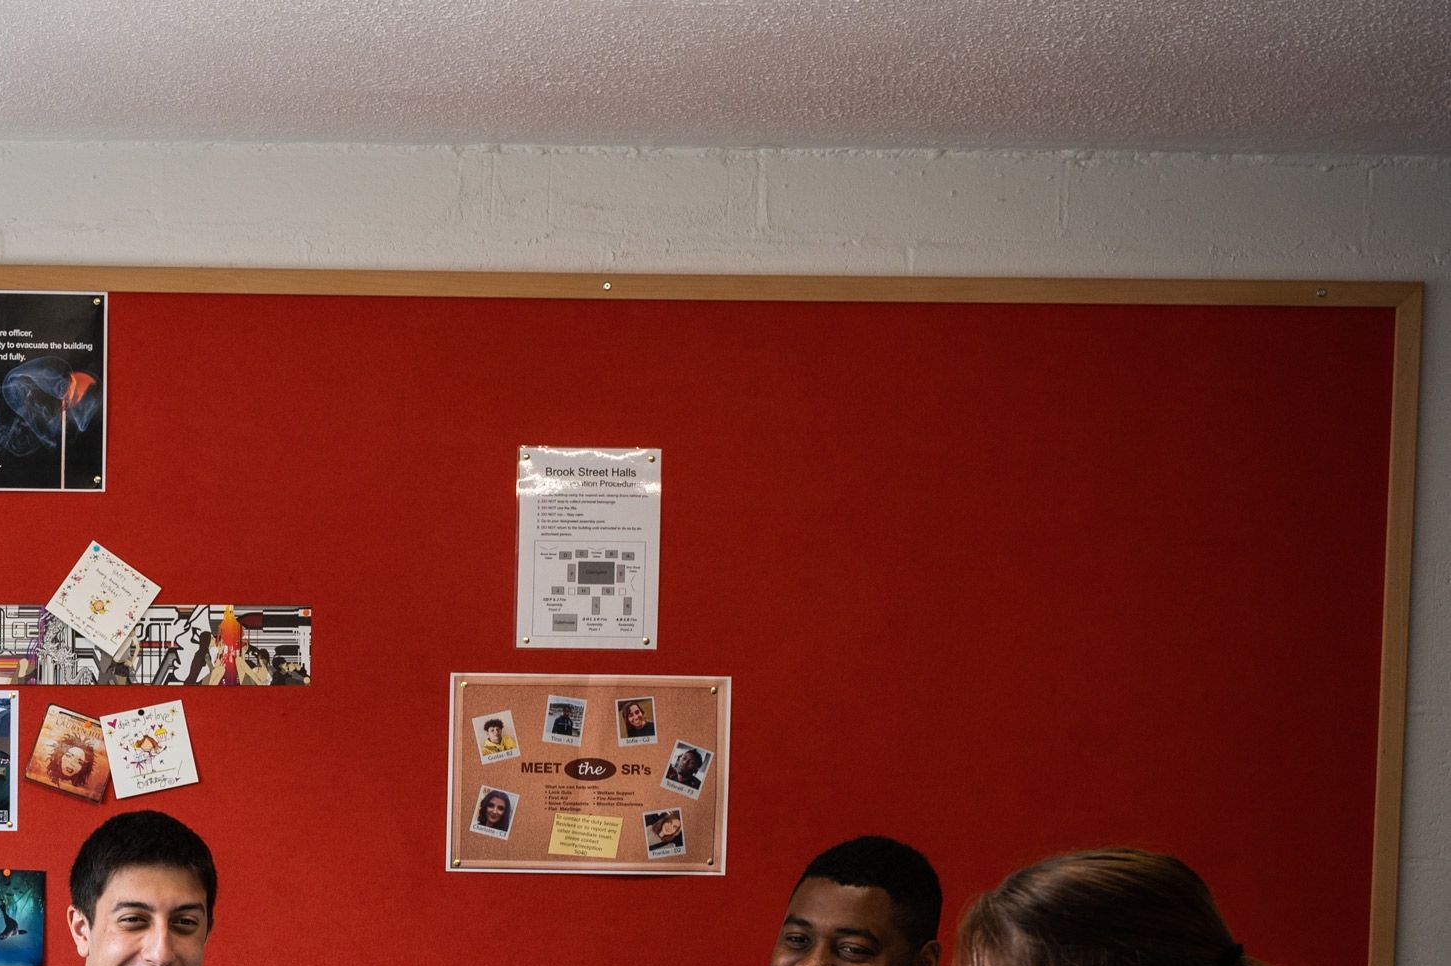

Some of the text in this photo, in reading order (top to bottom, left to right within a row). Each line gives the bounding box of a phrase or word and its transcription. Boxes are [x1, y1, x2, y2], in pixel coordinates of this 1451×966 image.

[8, 329, 34, 338] officer,
[6, 341, 15, 349] to
[15, 342, 49, 350] evacuate
[49, 341, 63, 350] the
[62, 342, 93, 352] building
[8, 352, 26, 362] fully.
[545, 467, 636, 477] Brook Street Halls
[521, 762, 651, 775] MEET the SR's
